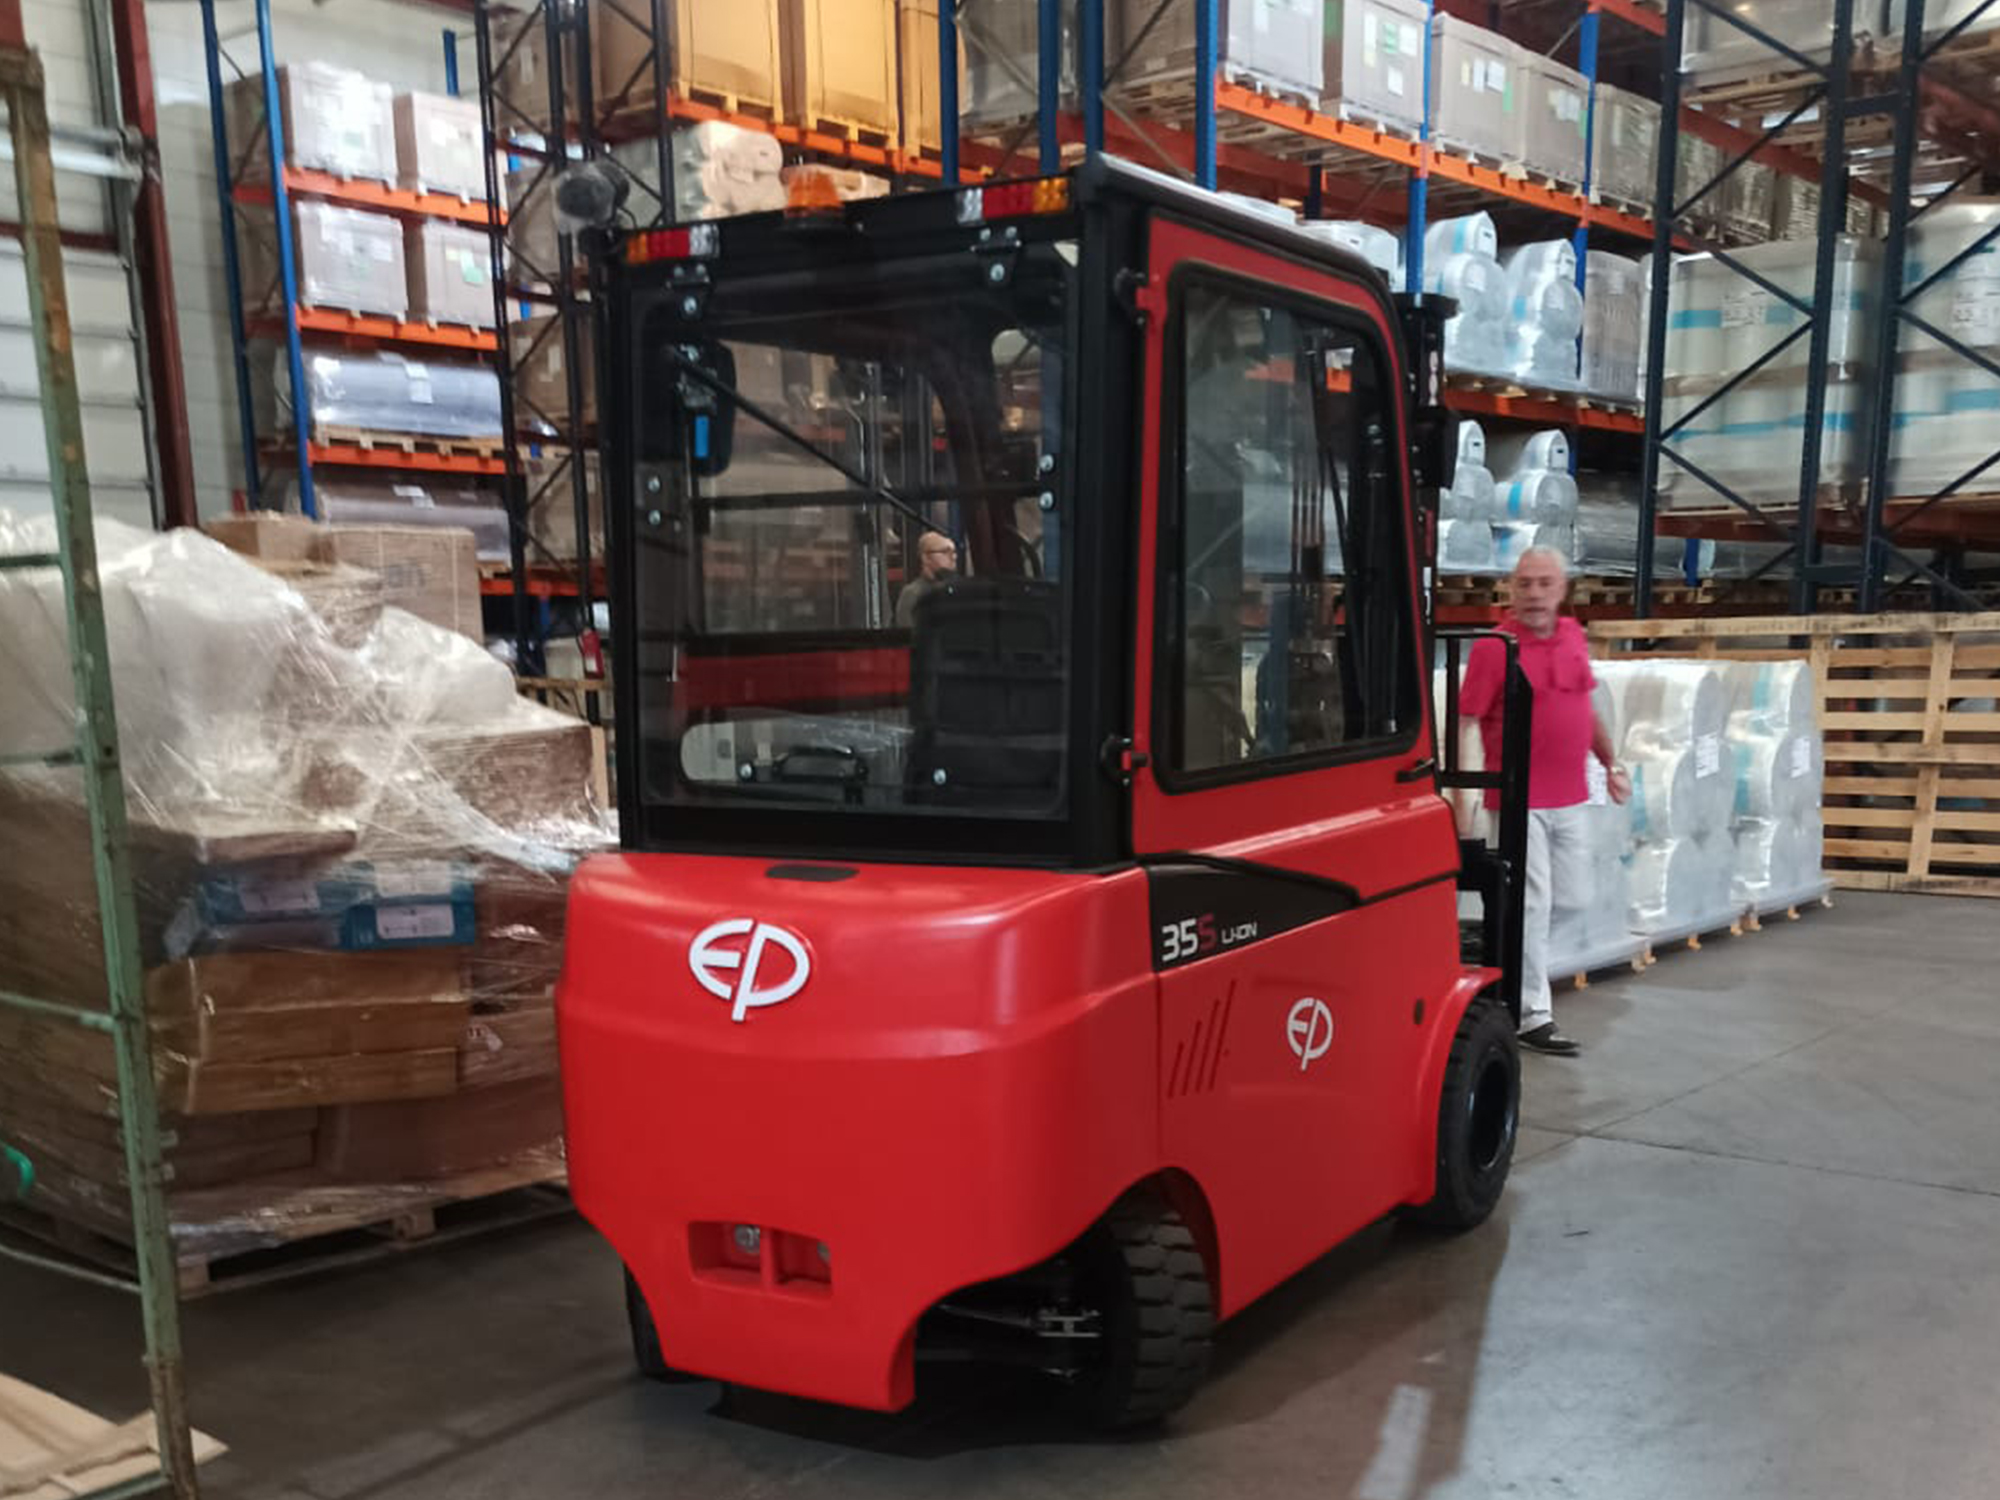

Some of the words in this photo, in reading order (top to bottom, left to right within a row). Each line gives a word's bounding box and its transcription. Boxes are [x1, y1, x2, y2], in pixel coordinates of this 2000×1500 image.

[689, 918, 810, 1021] EP
[1162, 912, 1217, 962] 35S
[1287, 997, 1334, 1071] EP
